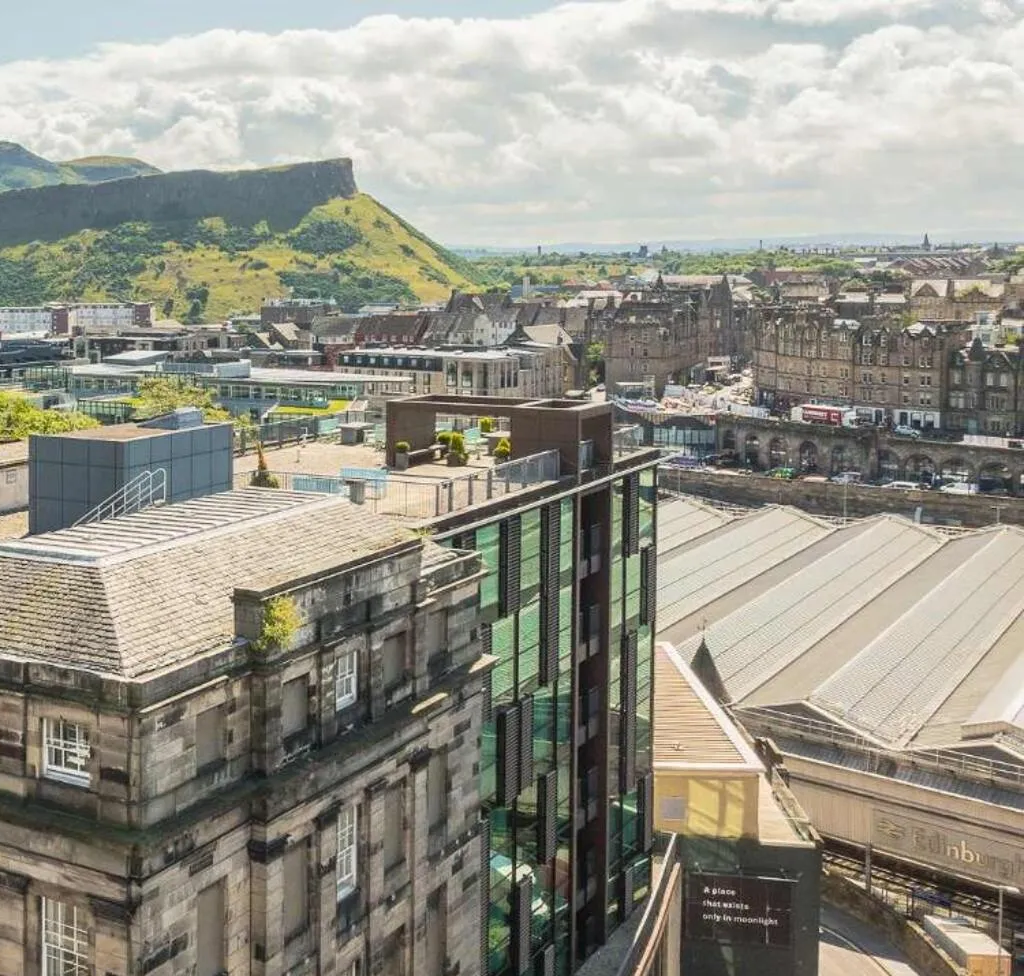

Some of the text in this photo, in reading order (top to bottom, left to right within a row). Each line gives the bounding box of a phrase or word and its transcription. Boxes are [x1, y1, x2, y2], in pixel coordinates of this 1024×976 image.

[712, 888, 736, 896] place
[703, 900, 749, 910] that exists
[703, 914, 721, 922] only
[734, 917, 778, 926] moonlight
